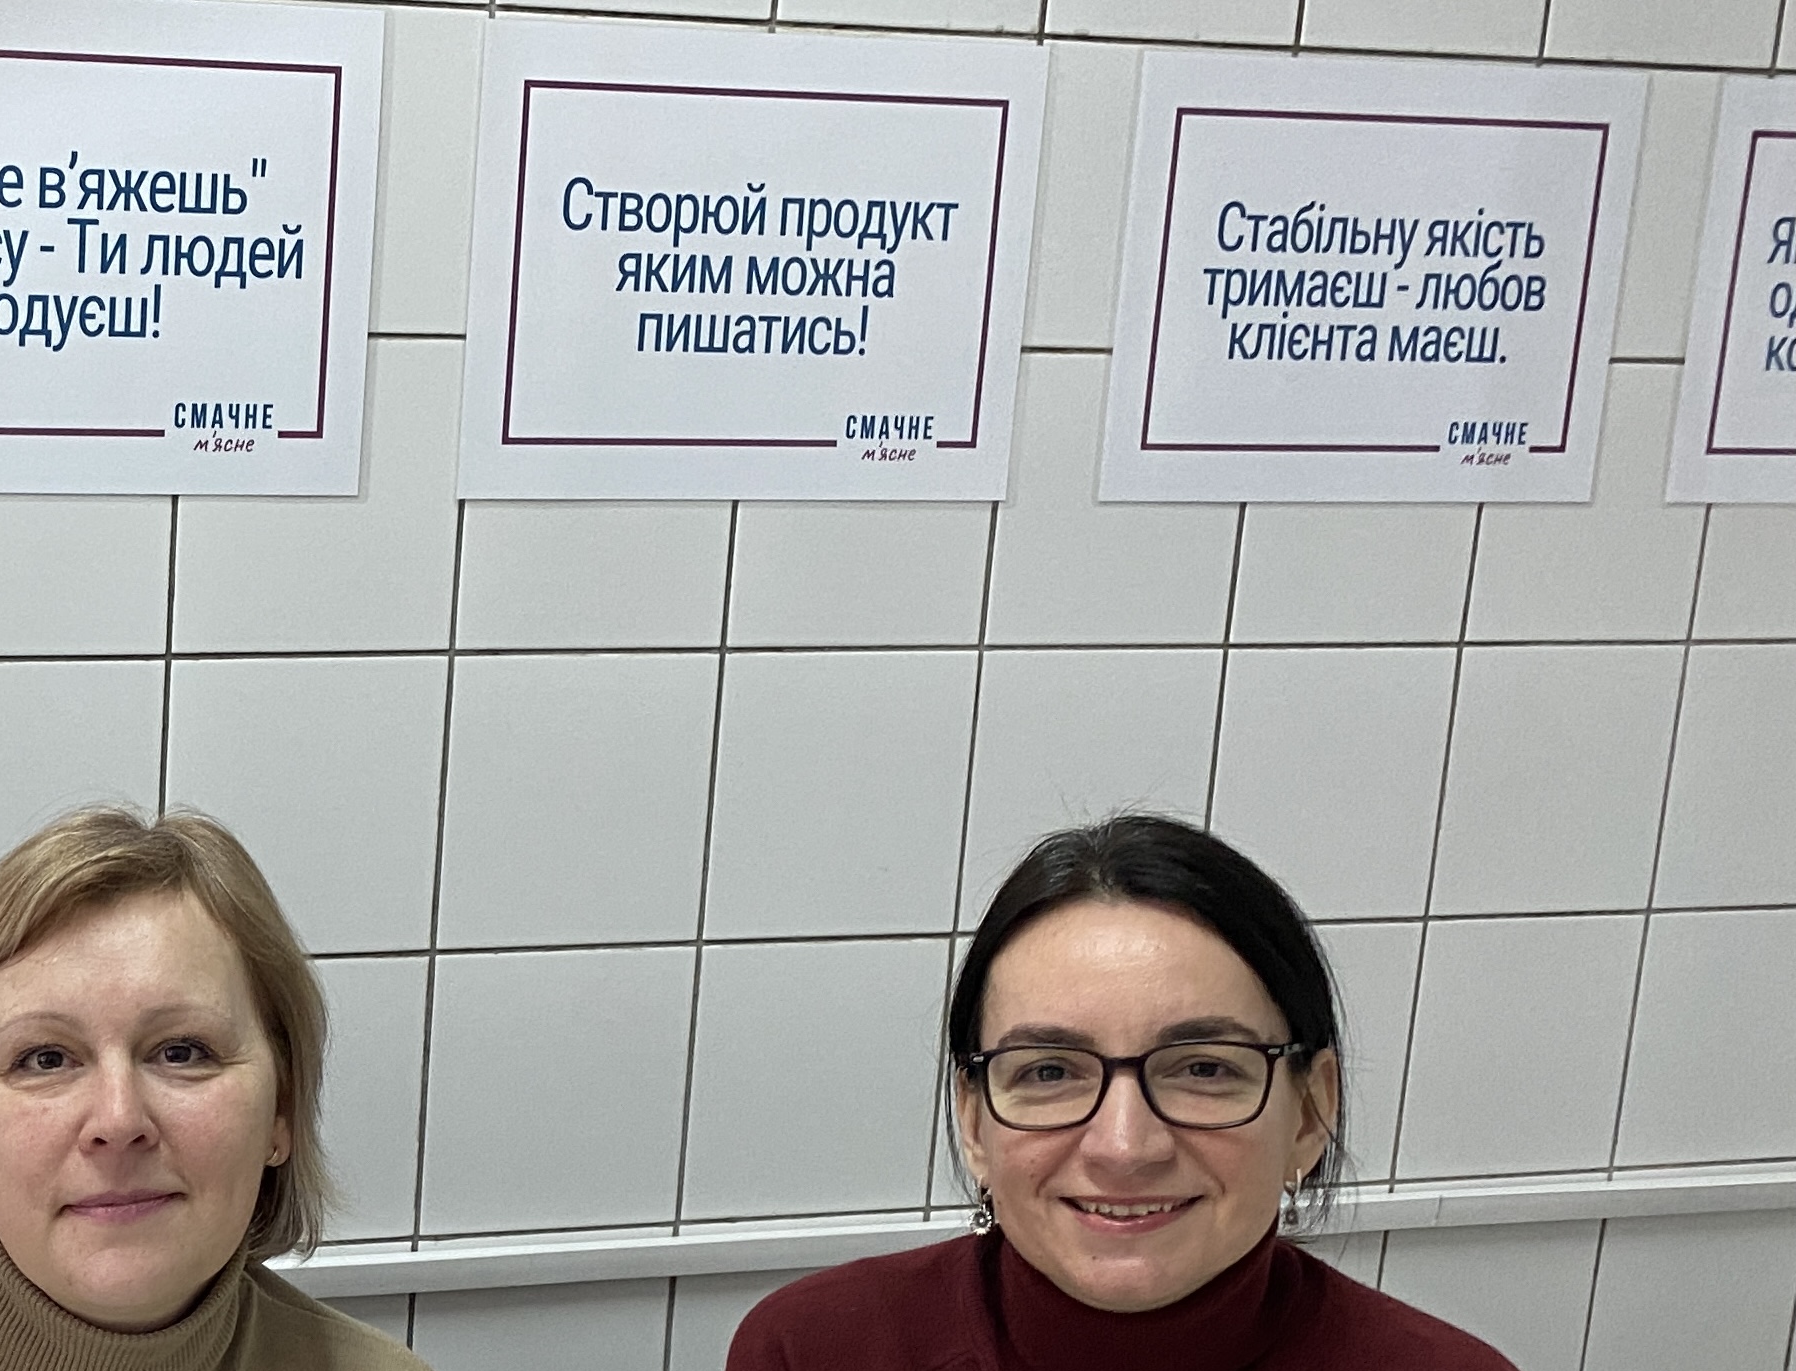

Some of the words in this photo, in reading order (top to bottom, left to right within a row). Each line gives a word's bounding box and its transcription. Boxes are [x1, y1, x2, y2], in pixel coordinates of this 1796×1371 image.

[562, 177, 767, 248] Створюй
[779, 197, 960, 255] продукт
[1217, 200, 1420, 271] Стабільну
[1423, 207, 1545, 259] якість
[67, 218, 128, 275] Ти
[140, 223, 304, 290] людей
[615, 252, 733, 295] яким
[745, 255, 896, 299] можна
[1203, 268, 1388, 320] тримаєш
[1415, 258, 1547, 312] любов
[637, 305, 869, 356] пишатись!
[1228, 310, 1378, 362] клієнта
[1387, 325, 1507, 364] маєш.
[174, 402, 274, 430] СМАЧНЕ
[845, 414, 935, 441] СМАЧНЕ
[1447, 421, 1529, 446] СМАЧНЕ
